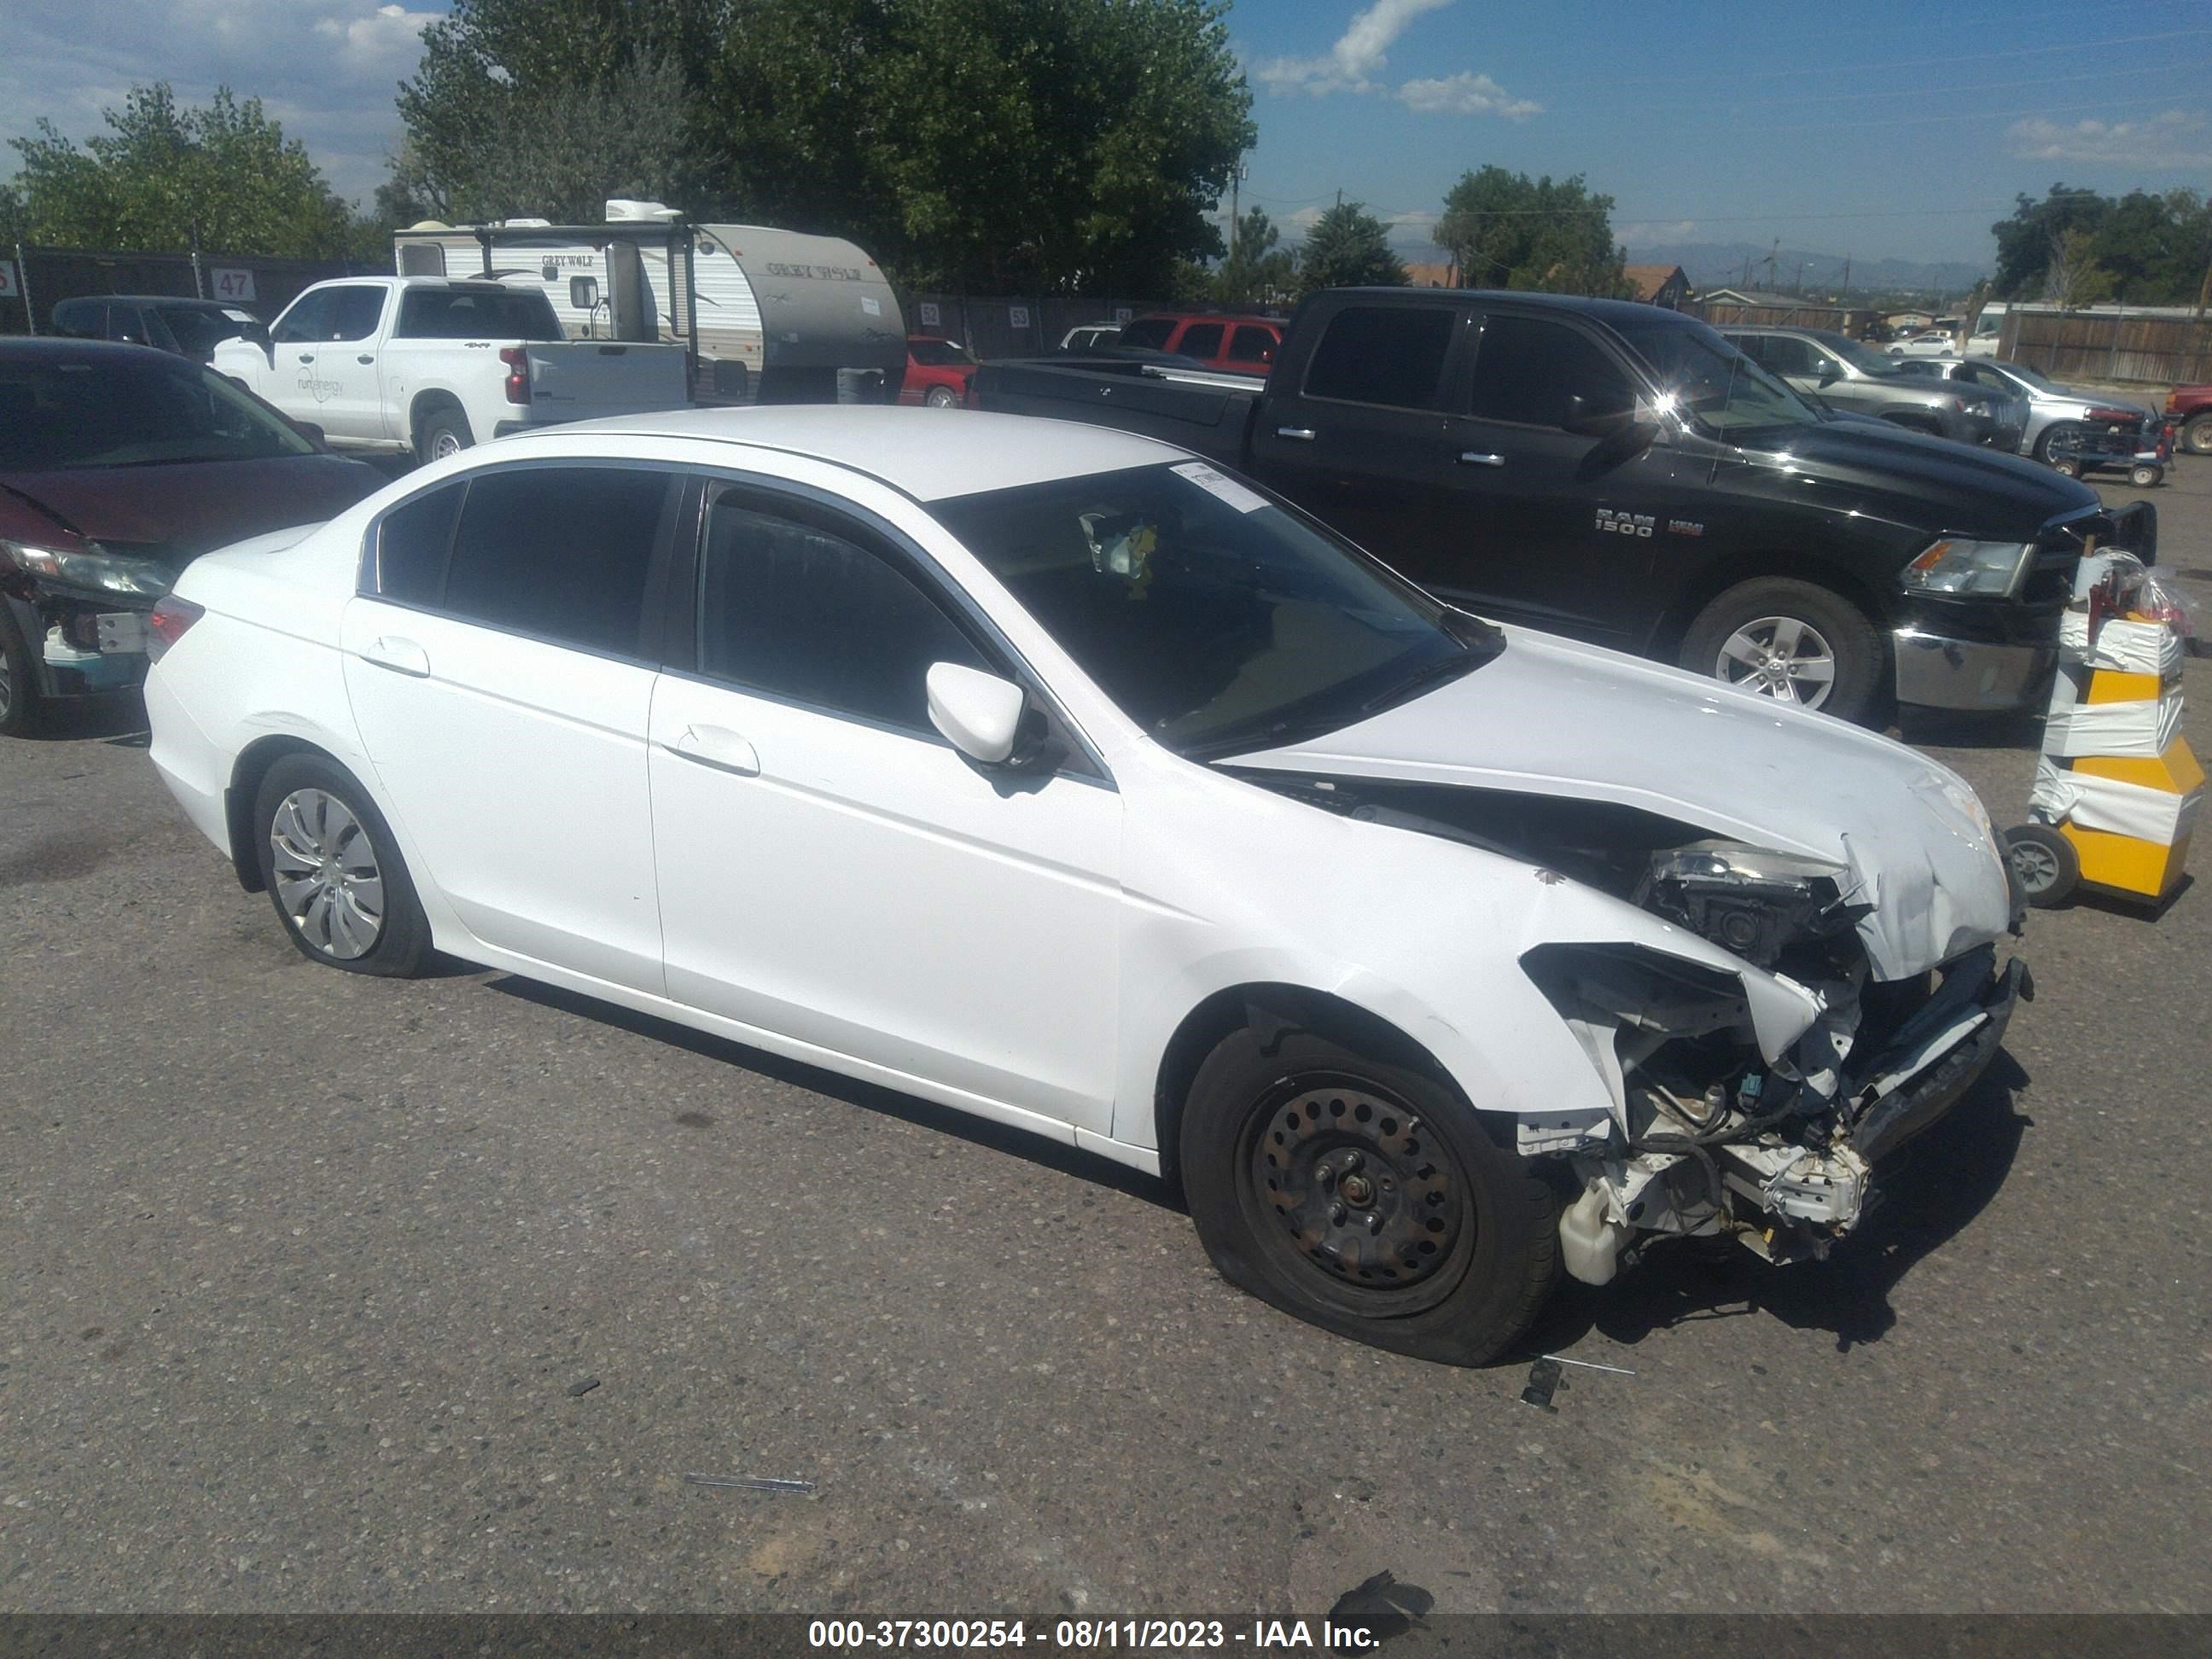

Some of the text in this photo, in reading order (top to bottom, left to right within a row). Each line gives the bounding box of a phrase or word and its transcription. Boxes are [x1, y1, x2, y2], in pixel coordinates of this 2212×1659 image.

[542, 255, 594, 266] GREY WOLF
[766, 263, 812, 278] GREY
[220, 273, 246, 296] 47
[923, 306, 937, 322] 52
[1012, 310, 1027, 324] 53
[1597, 508, 1656, 527] RAM
[1669, 519, 1704, 530] HEMI
[1595, 519, 1654, 538] 1500
